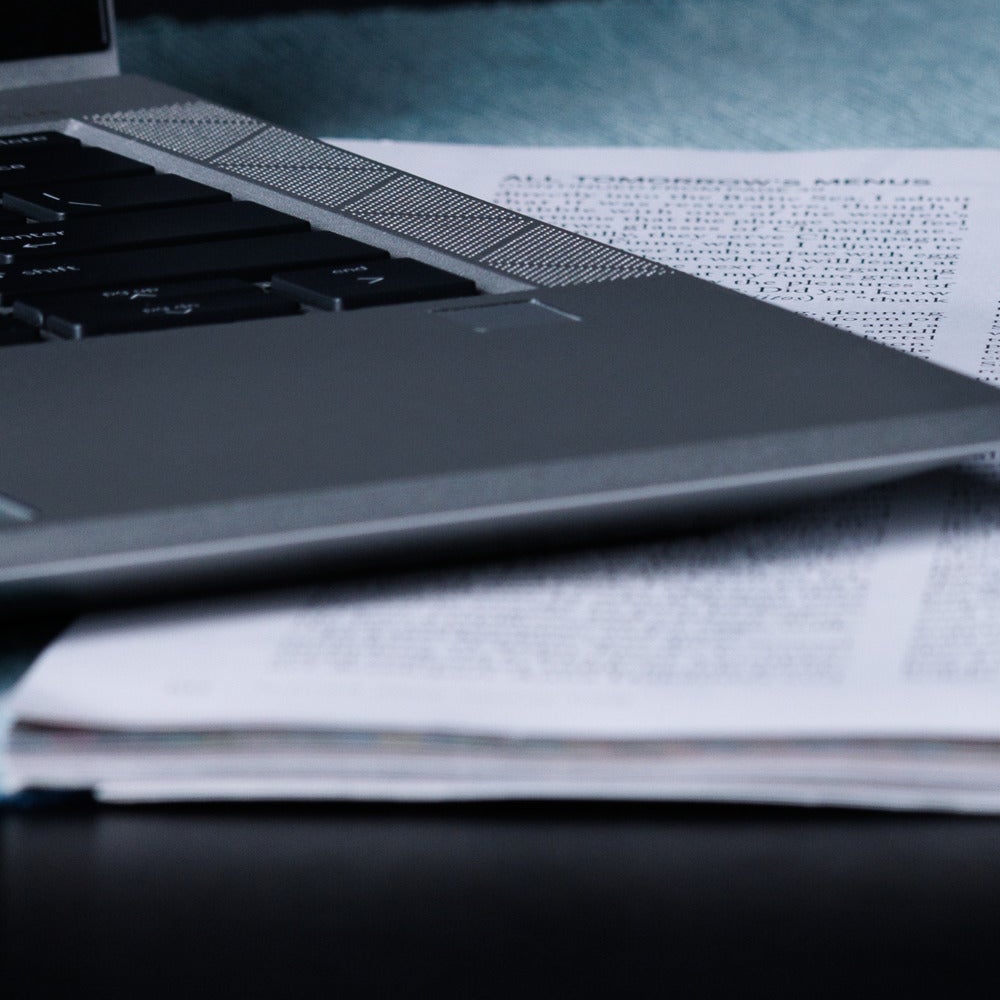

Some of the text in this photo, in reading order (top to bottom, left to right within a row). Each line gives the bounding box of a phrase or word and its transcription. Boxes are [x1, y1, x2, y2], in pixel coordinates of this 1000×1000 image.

[502, 174, 563, 185] ALL
[813, 178, 932, 187] MENUS
[824, 266, 956, 275] regarding
[787, 279, 913, 288] pleasures
[758, 285, 809, 293] Did
[876, 287, 948, 296] know
